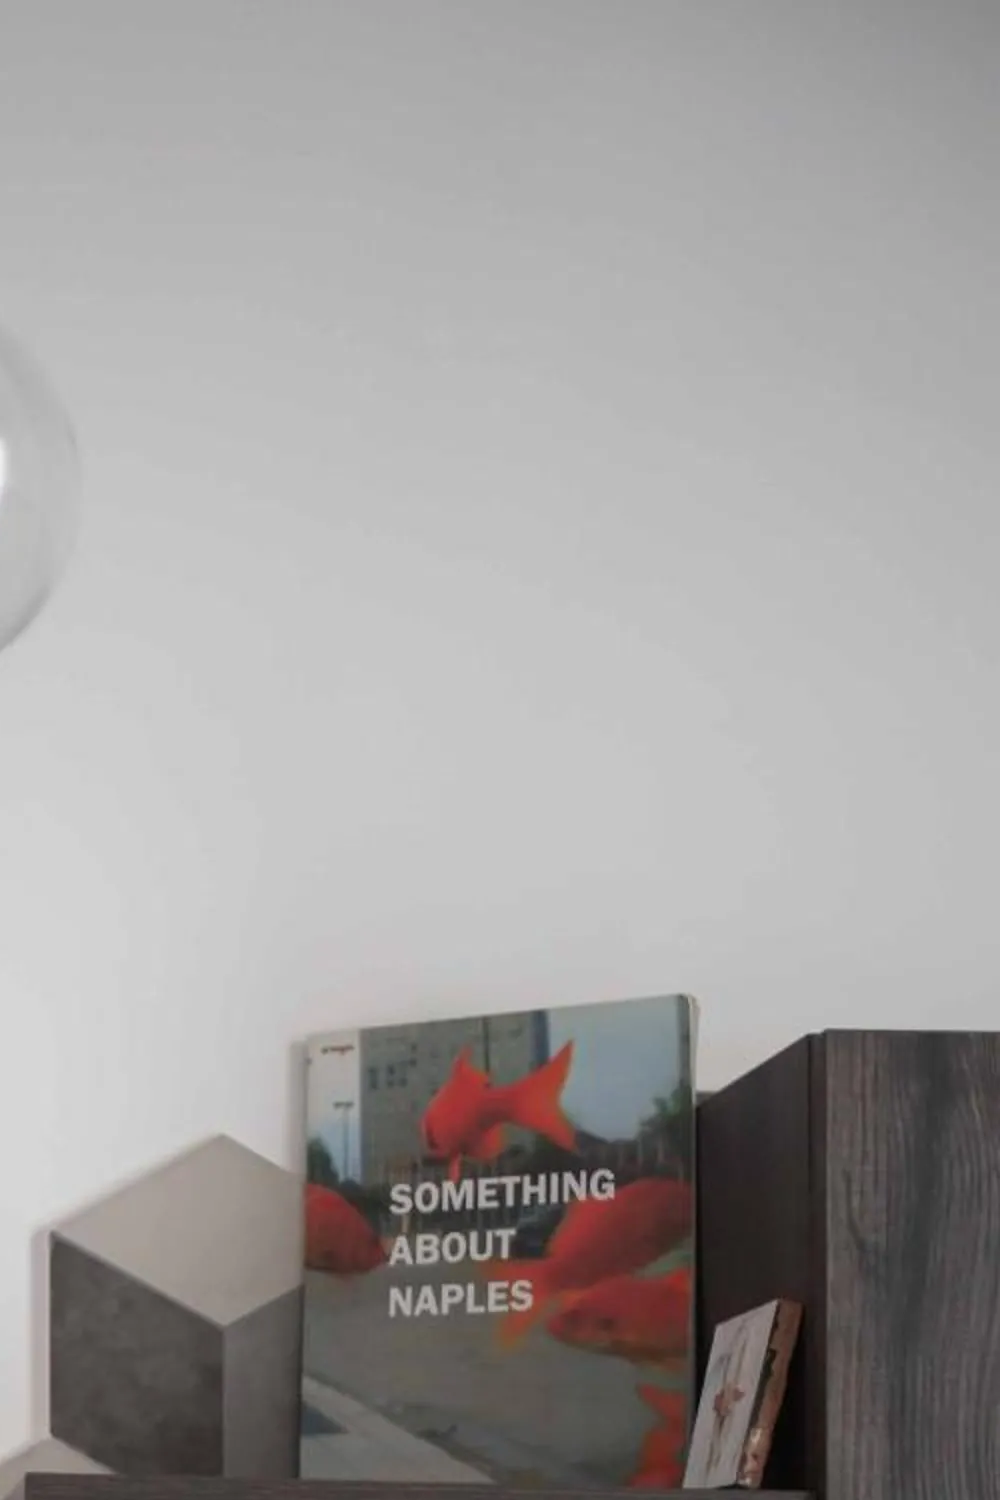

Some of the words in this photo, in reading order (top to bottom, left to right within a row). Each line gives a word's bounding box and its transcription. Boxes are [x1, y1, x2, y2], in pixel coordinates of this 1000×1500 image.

[389, 1168, 616, 1215] SOMETHING
[389, 1229, 516, 1267] ABOUT
[388, 1280, 534, 1318] NAPLES
